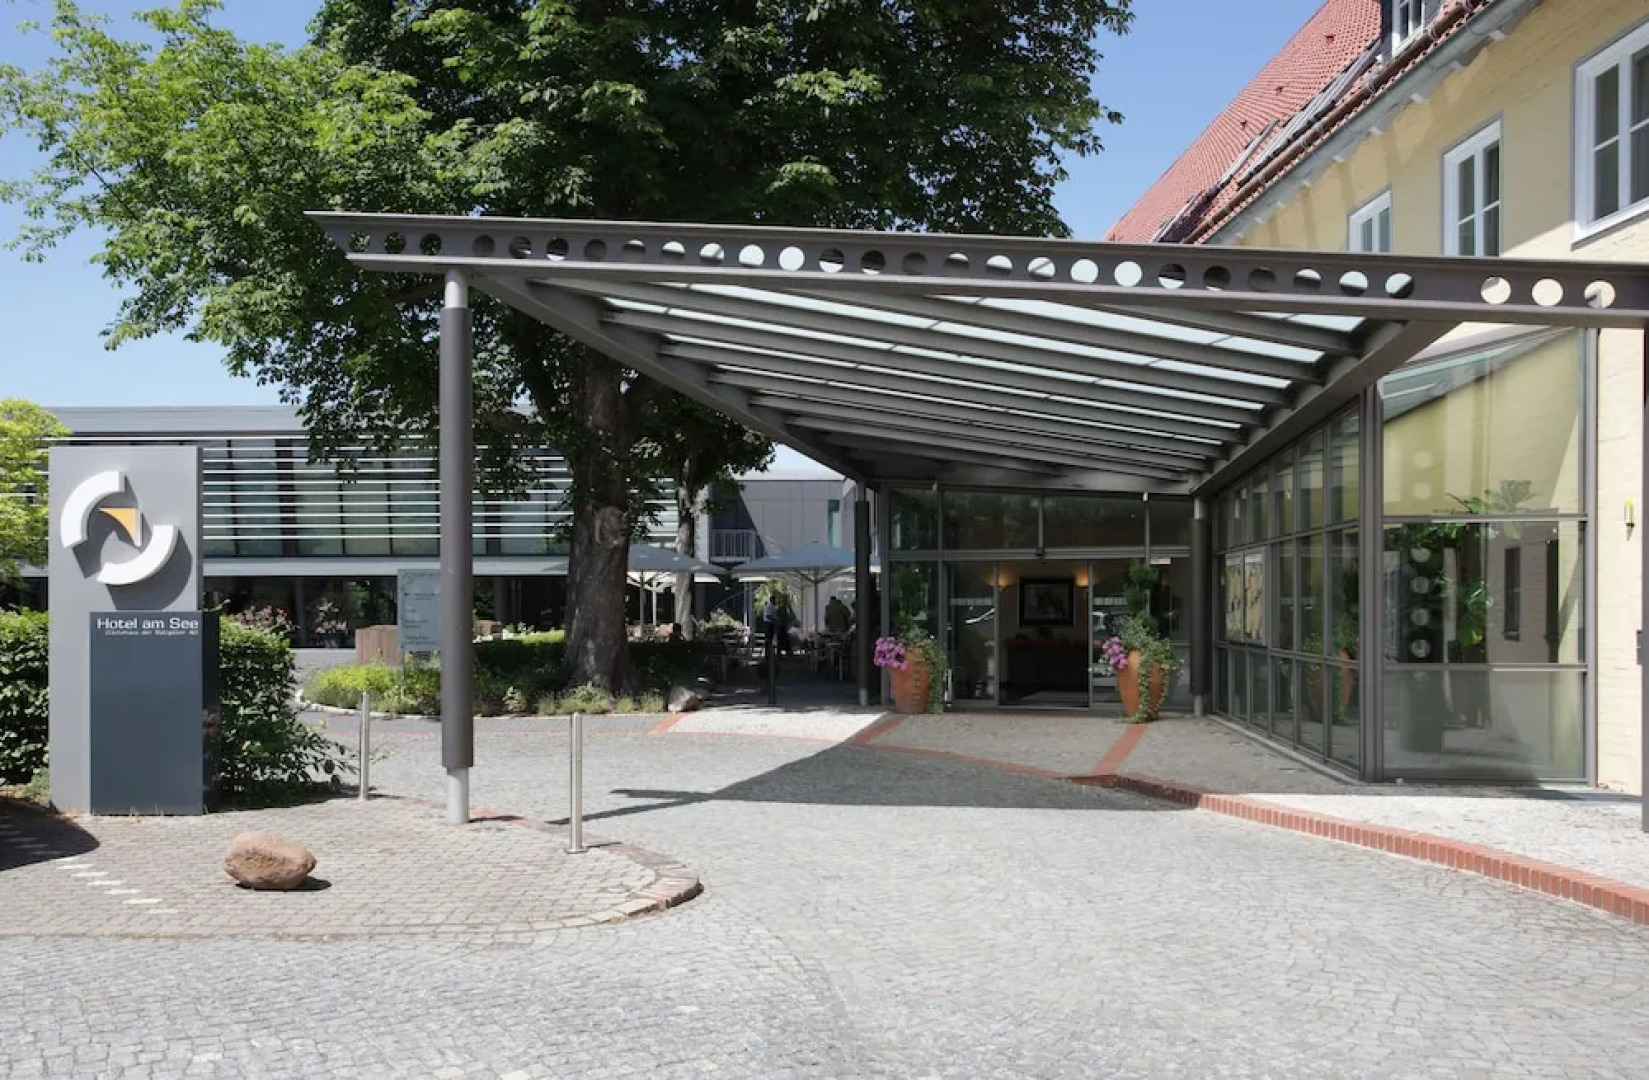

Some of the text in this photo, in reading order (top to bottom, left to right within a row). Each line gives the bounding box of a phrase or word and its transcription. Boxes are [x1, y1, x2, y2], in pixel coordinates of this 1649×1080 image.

[97, 617, 199, 629] Hotel am See
